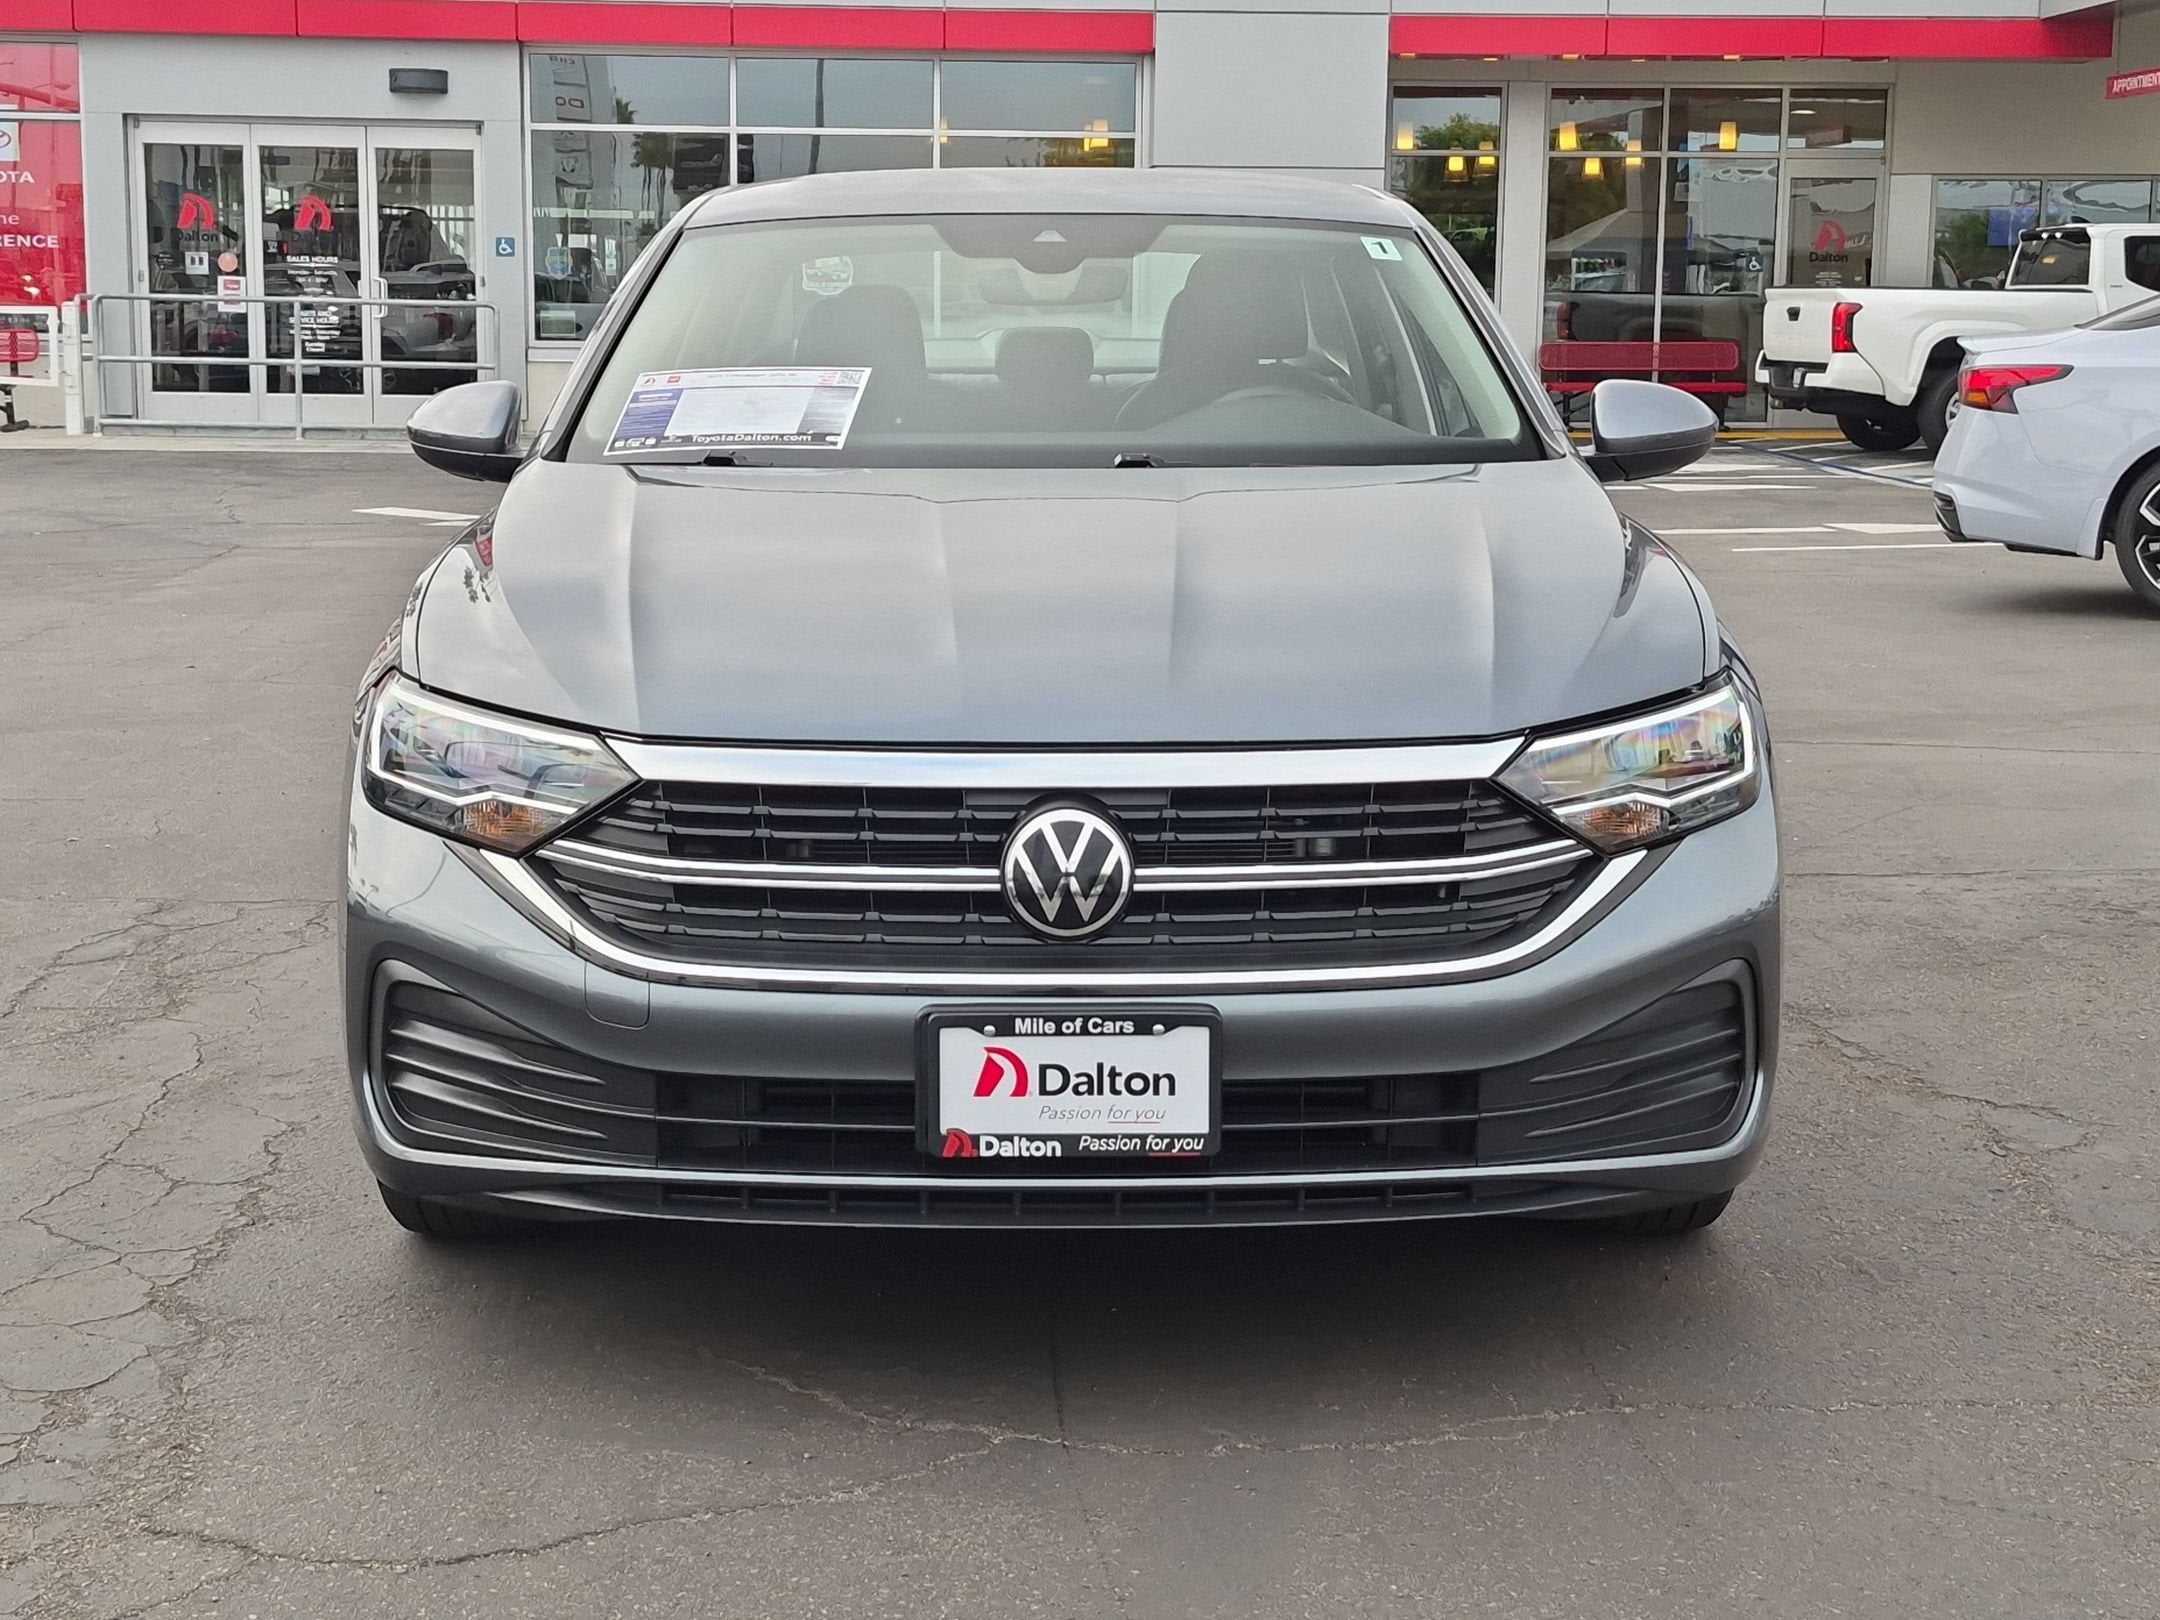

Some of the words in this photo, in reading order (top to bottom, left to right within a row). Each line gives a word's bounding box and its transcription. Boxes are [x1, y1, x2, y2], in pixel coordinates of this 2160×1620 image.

[0, 234, 60, 248] ENCE
[1371, 241, 1388, 254] 1
[1809, 251, 1849, 263] Dalton
[691, 433, 812, 444] ToyotaDalton.com
[1015, 1017, 1056, 1034] Mile
[1061, 1017, 1084, 1034] of
[1087, 1017, 1135, 1034] Cars
[1038, 1061, 1177, 1097] Dalton
[1038, 1105, 1102, 1120] Passion
[1107, 1104, 1132, 1120] for
[1135, 1109, 1166, 1122] you
[978, 1135, 1063, 1158] Dalton
[1078, 1135, 1141, 1151] Passion
[1145, 1135, 1170, 1151] for
[1172, 1137, 1205, 1154] you
